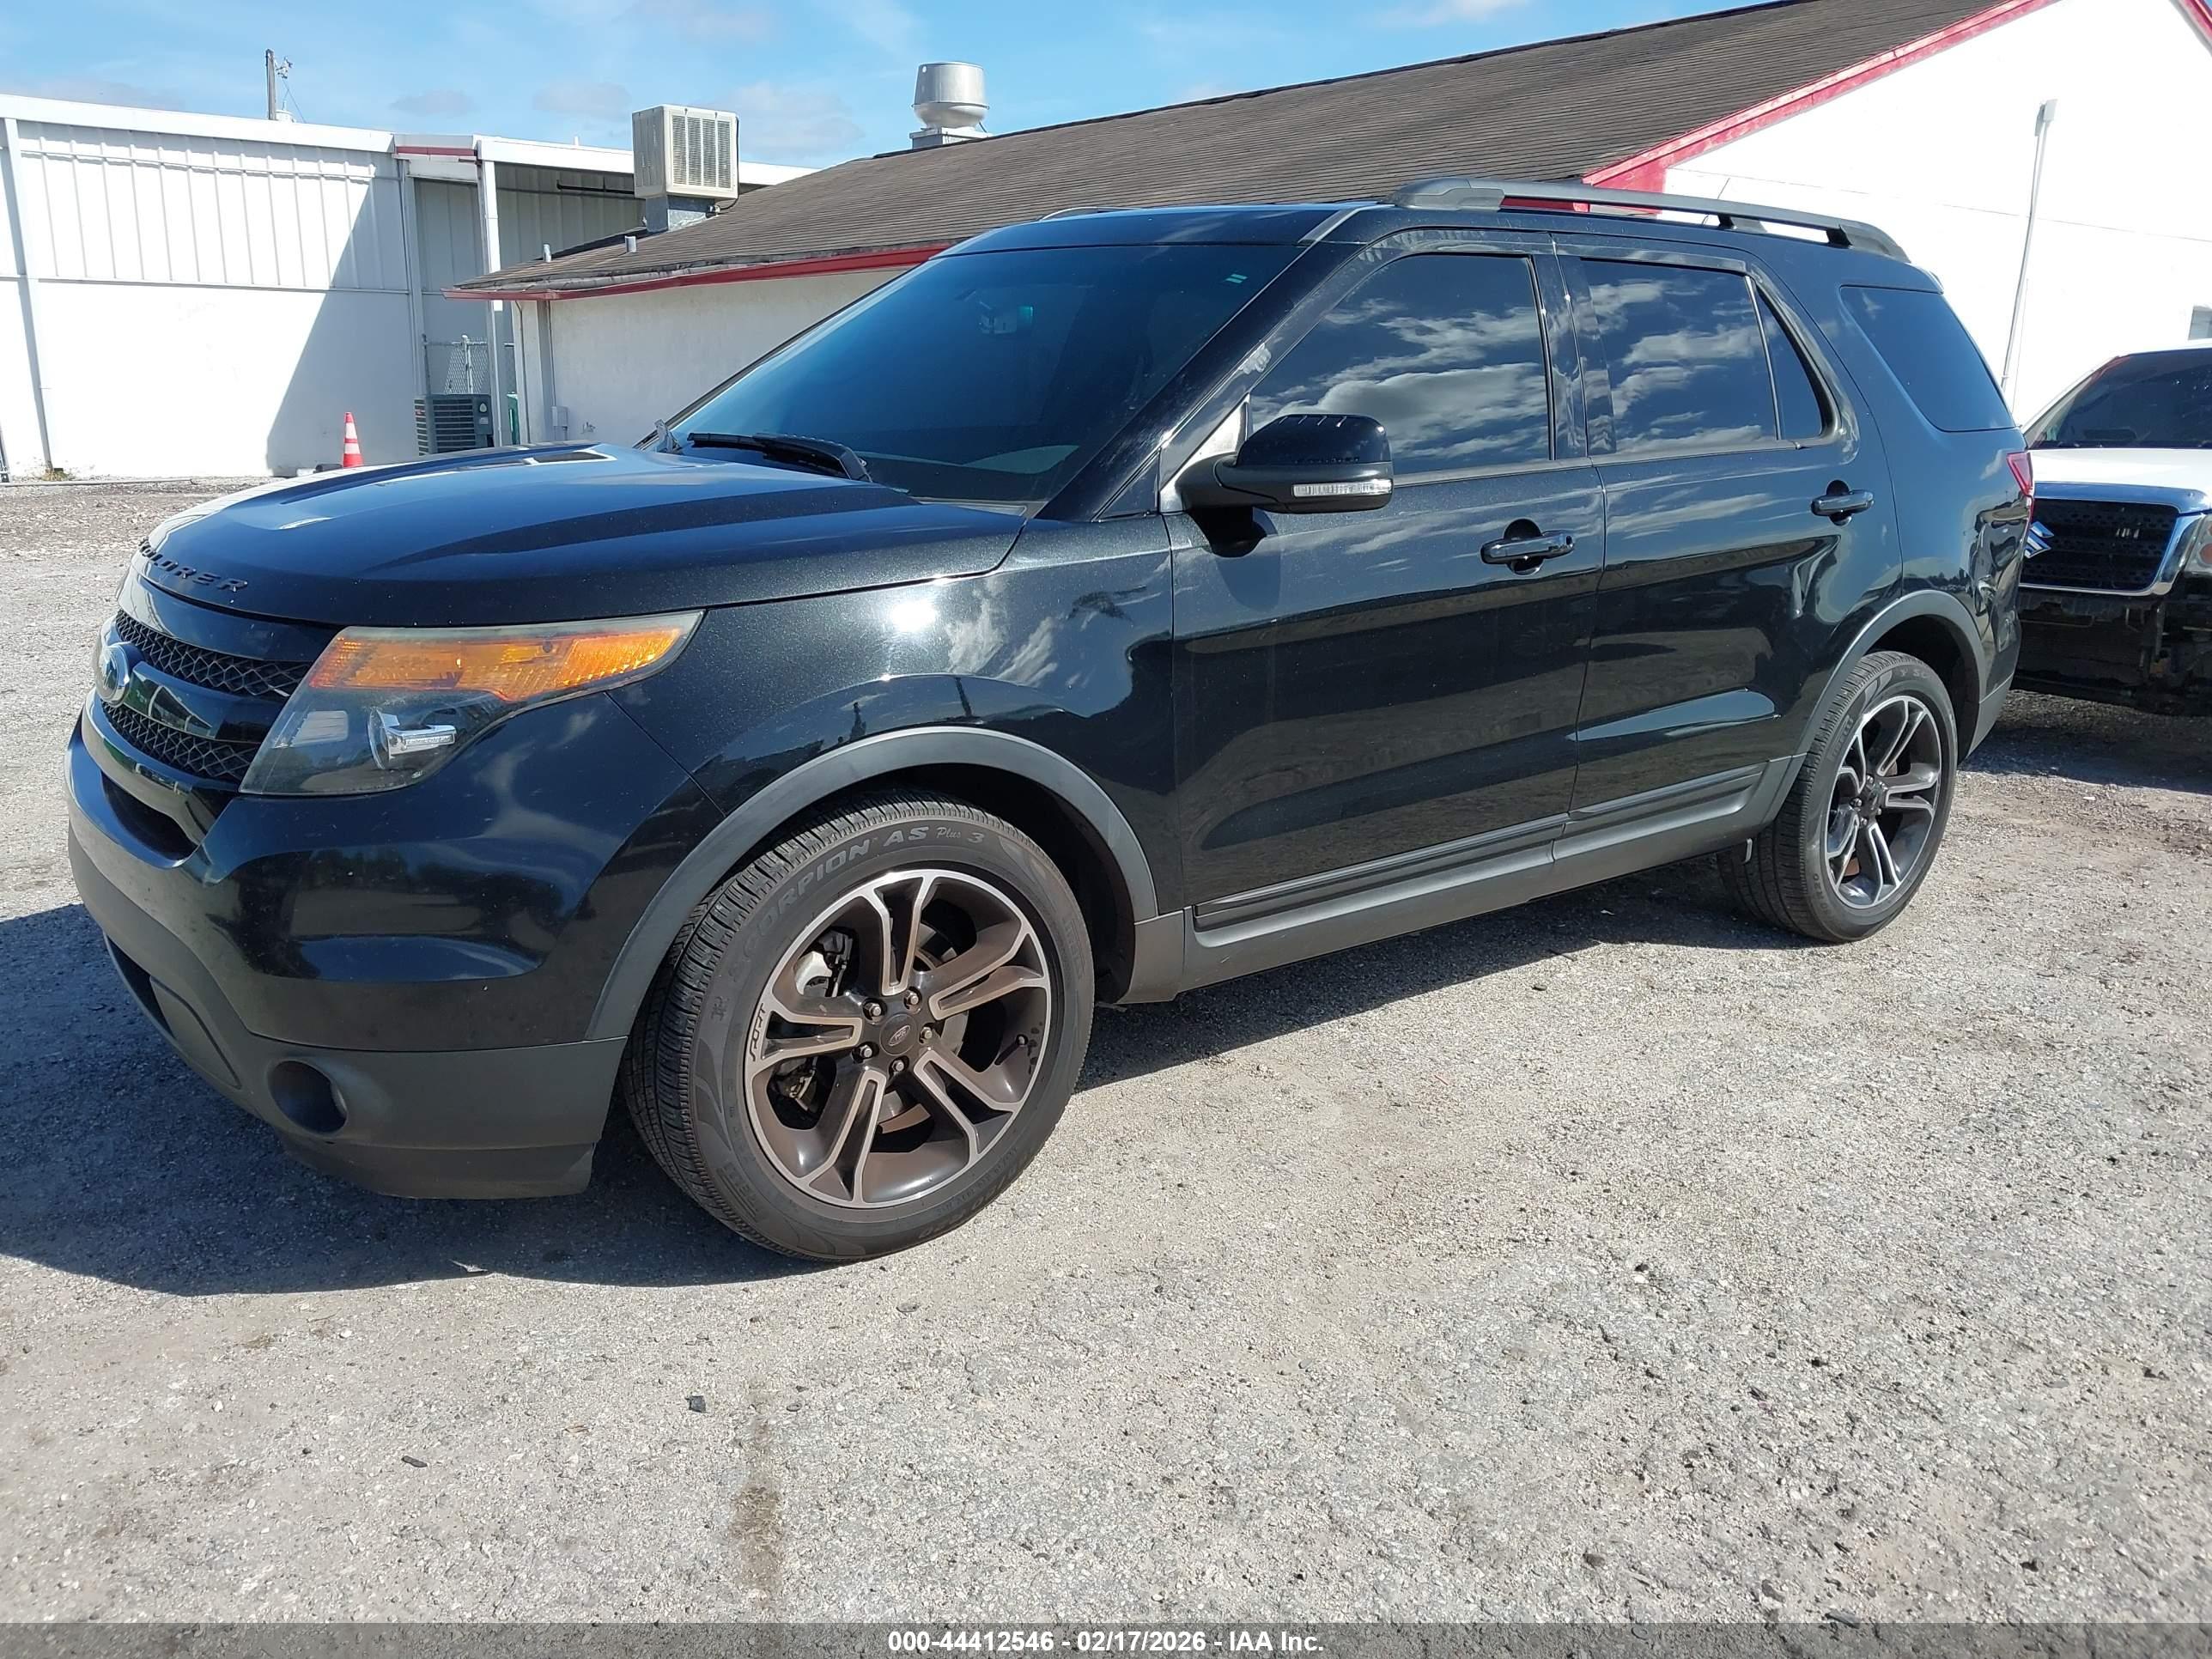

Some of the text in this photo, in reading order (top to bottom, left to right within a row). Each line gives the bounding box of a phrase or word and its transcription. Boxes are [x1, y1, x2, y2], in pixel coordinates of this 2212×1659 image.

[883, 826, 930, 848] AS
[936, 827, 962, 839] Plus
[968, 832, 985, 844] 3
